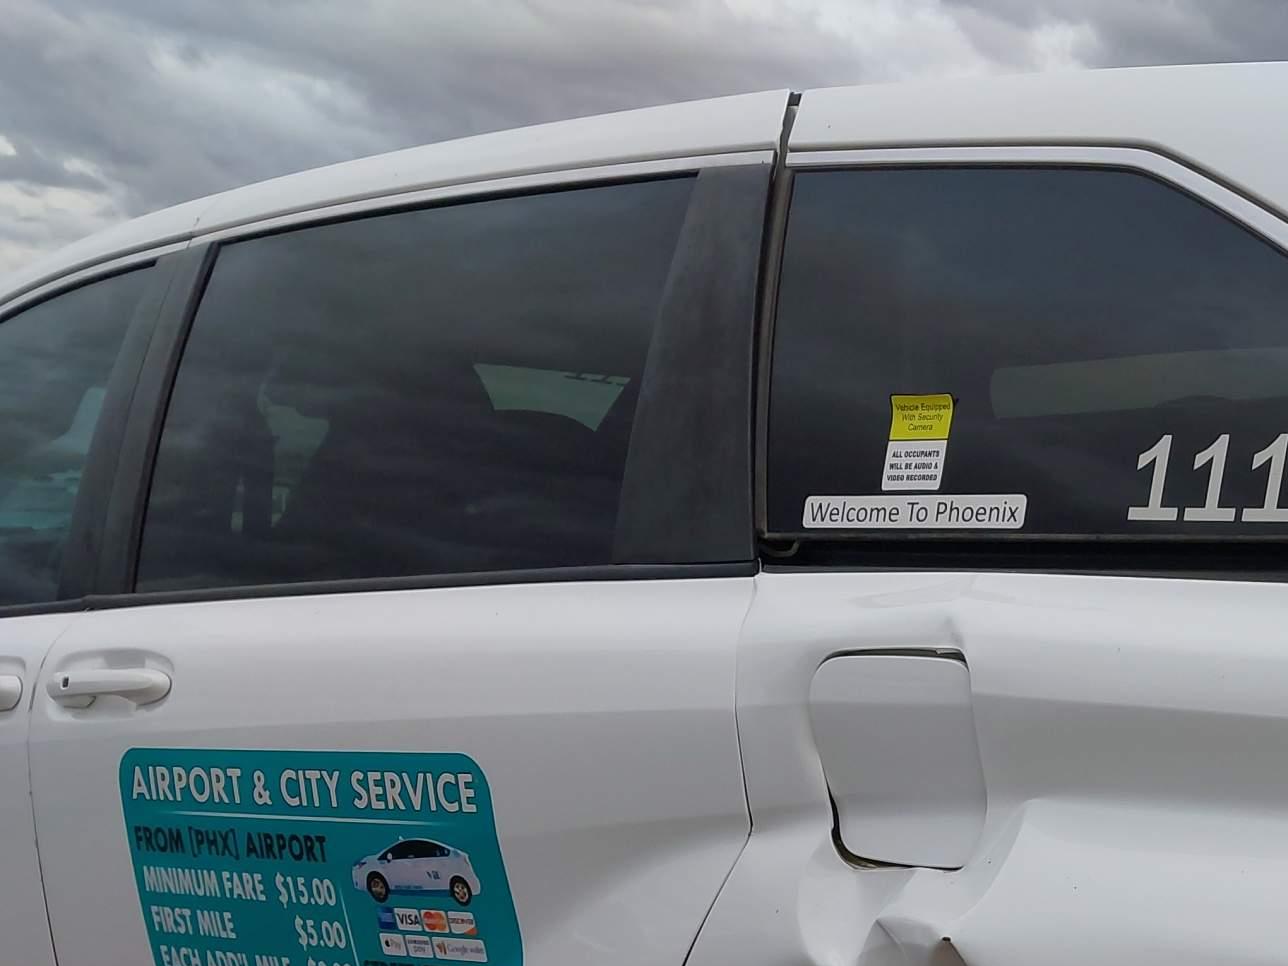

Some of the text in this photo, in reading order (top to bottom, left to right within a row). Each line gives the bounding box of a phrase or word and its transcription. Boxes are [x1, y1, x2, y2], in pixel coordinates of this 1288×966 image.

[895, 402, 951, 412] Vehicle Equipped
[902, 413, 944, 422] With Security
[892, 450, 940, 458] ALL OCCUPANTS
[889, 462, 903, 470] WILL
[904, 462, 913, 470] BE
[913, 462, 933, 470] AUDIO
[809, 500, 1020, 523] Welcome To Phoenix
[132, 766, 478, 813] AIRPORT & CITY SERVICE
[134, 825, 184, 853] FROM
[246, 831, 326, 863] AIRPORT
[143, 865, 336, 908] MINIMUM FARE $15.00
[150, 905, 346, 951] FIRST MILE $5.00
[397, 912, 421, 926] VISA
